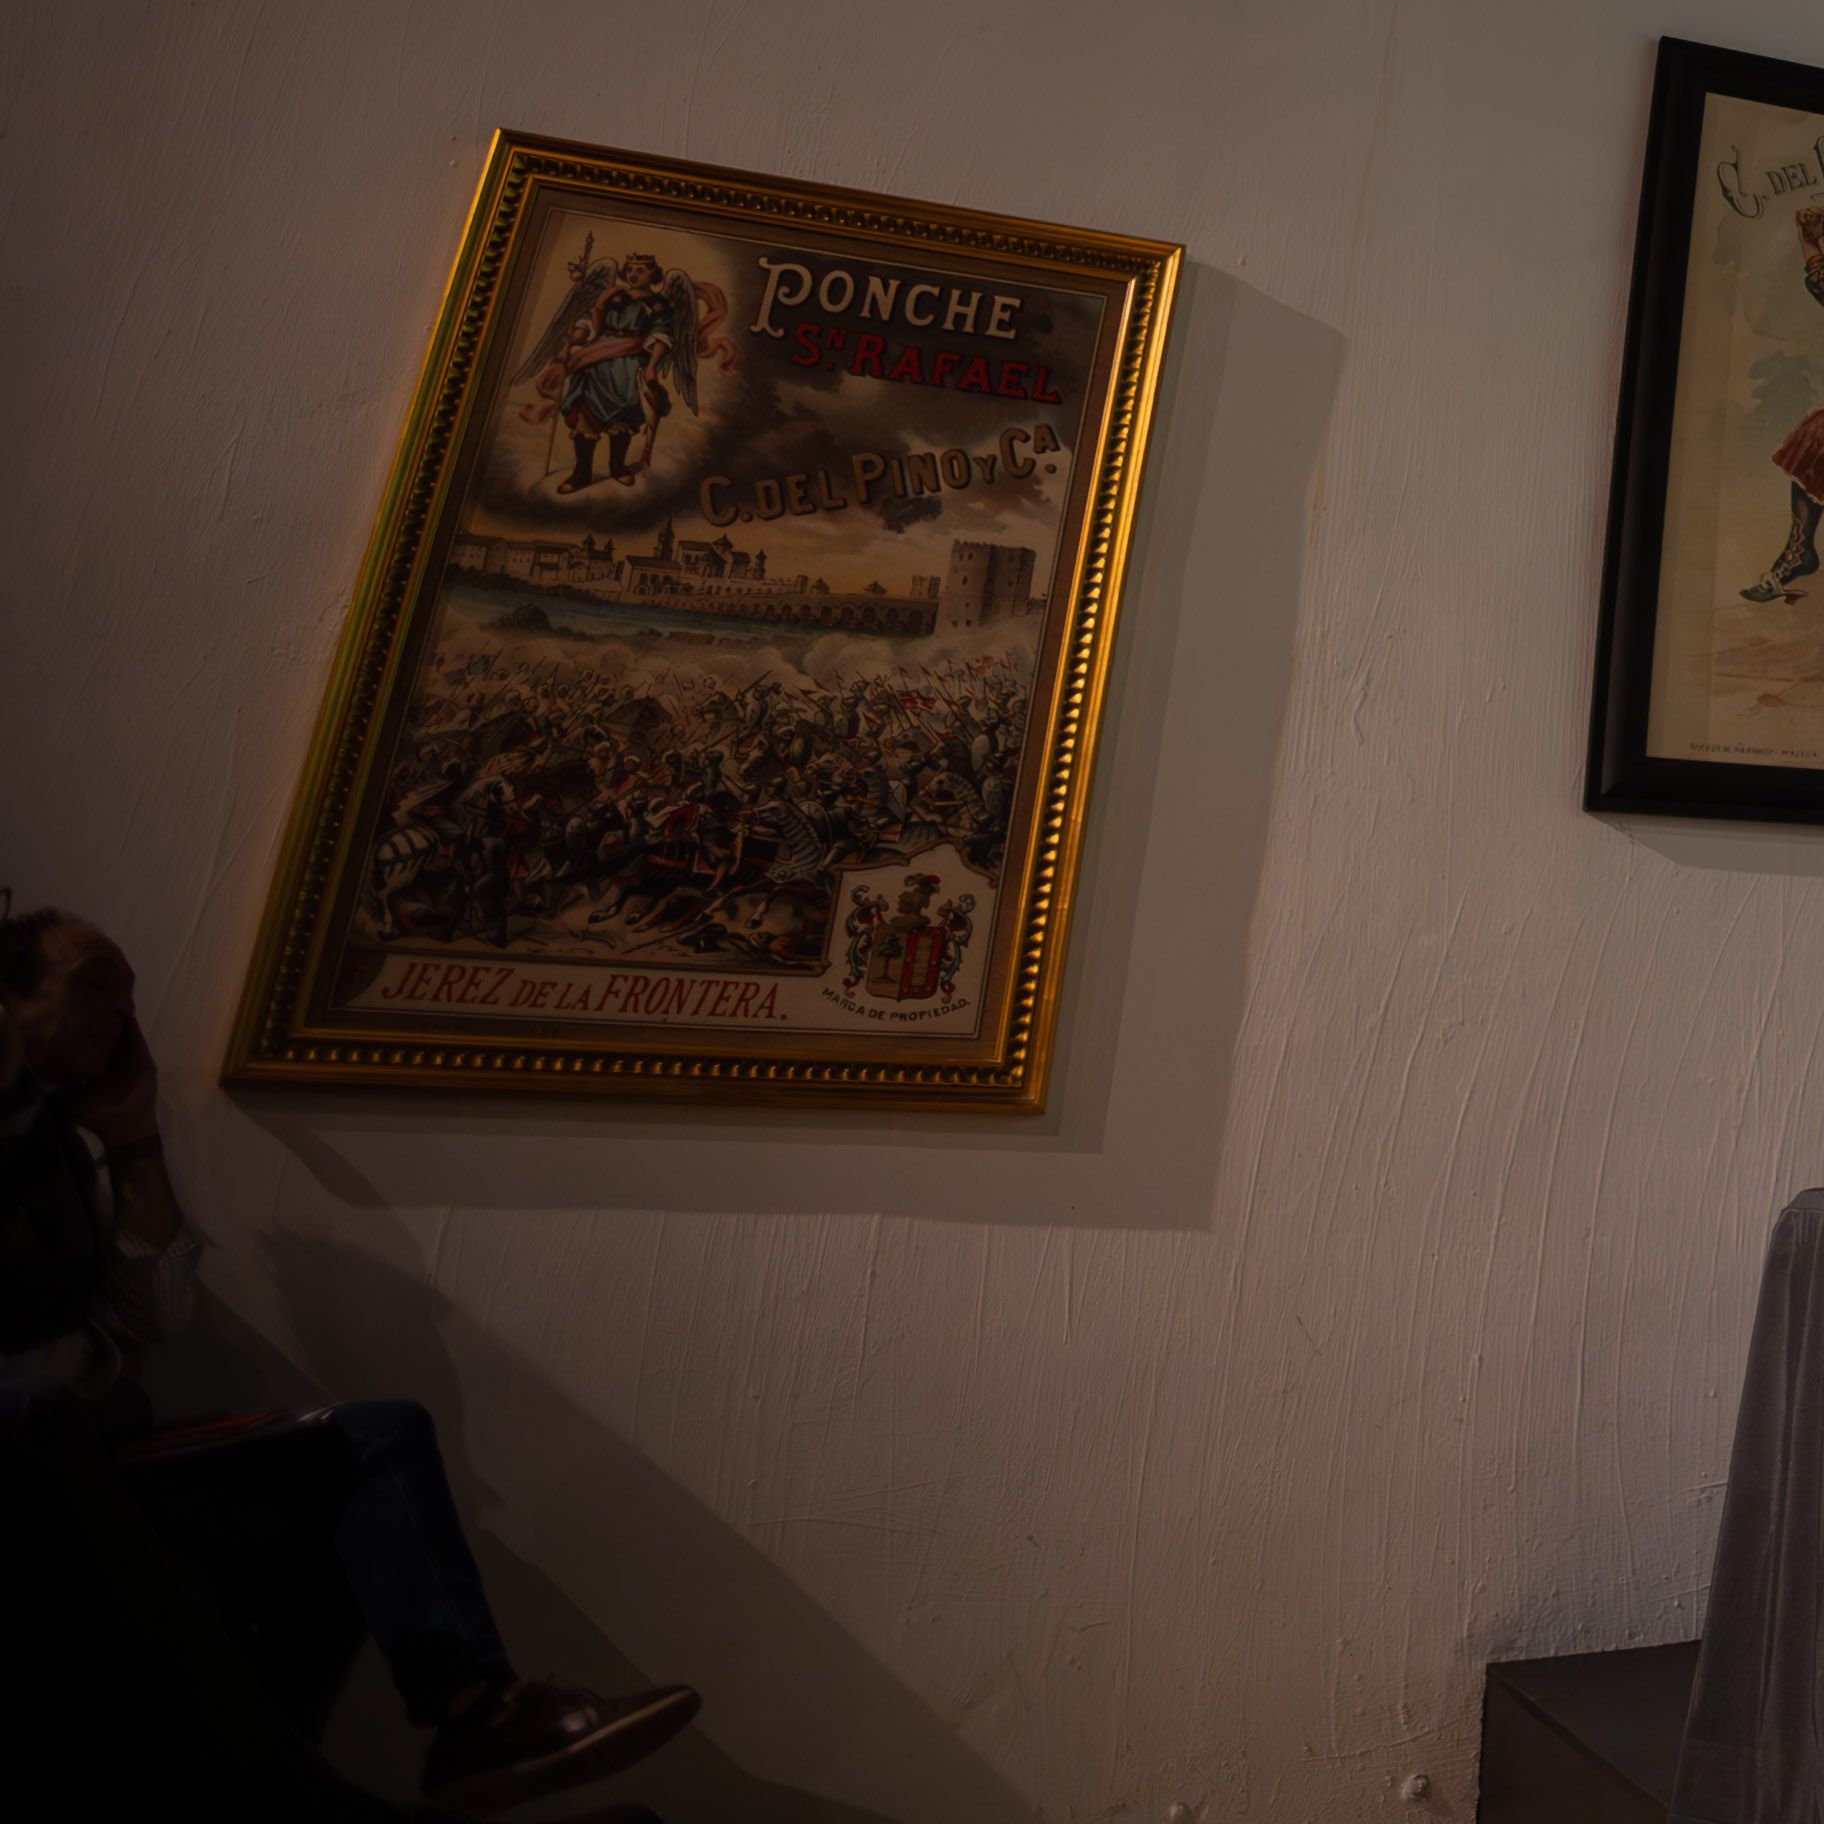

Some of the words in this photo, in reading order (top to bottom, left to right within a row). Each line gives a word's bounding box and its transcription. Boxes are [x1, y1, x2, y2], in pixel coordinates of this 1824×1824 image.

[1766, 161, 1820, 196] DEL
[749, 254, 1025, 342] PONCHE
[847, 331, 1063, 406] RAFAEL
[754, 466, 848, 522] DEL
[850, 448, 972, 506] PINO
[973, 452, 997, 485] Y
[382, 961, 514, 1005] JEREZ
[508, 979, 549, 1009] DE
[560, 982, 591, 1012] LA
[592, 973, 788, 1022] FRONTERA.
[821, 987, 865, 1018] MARCA
[868, 1007, 886, 1020] DE
